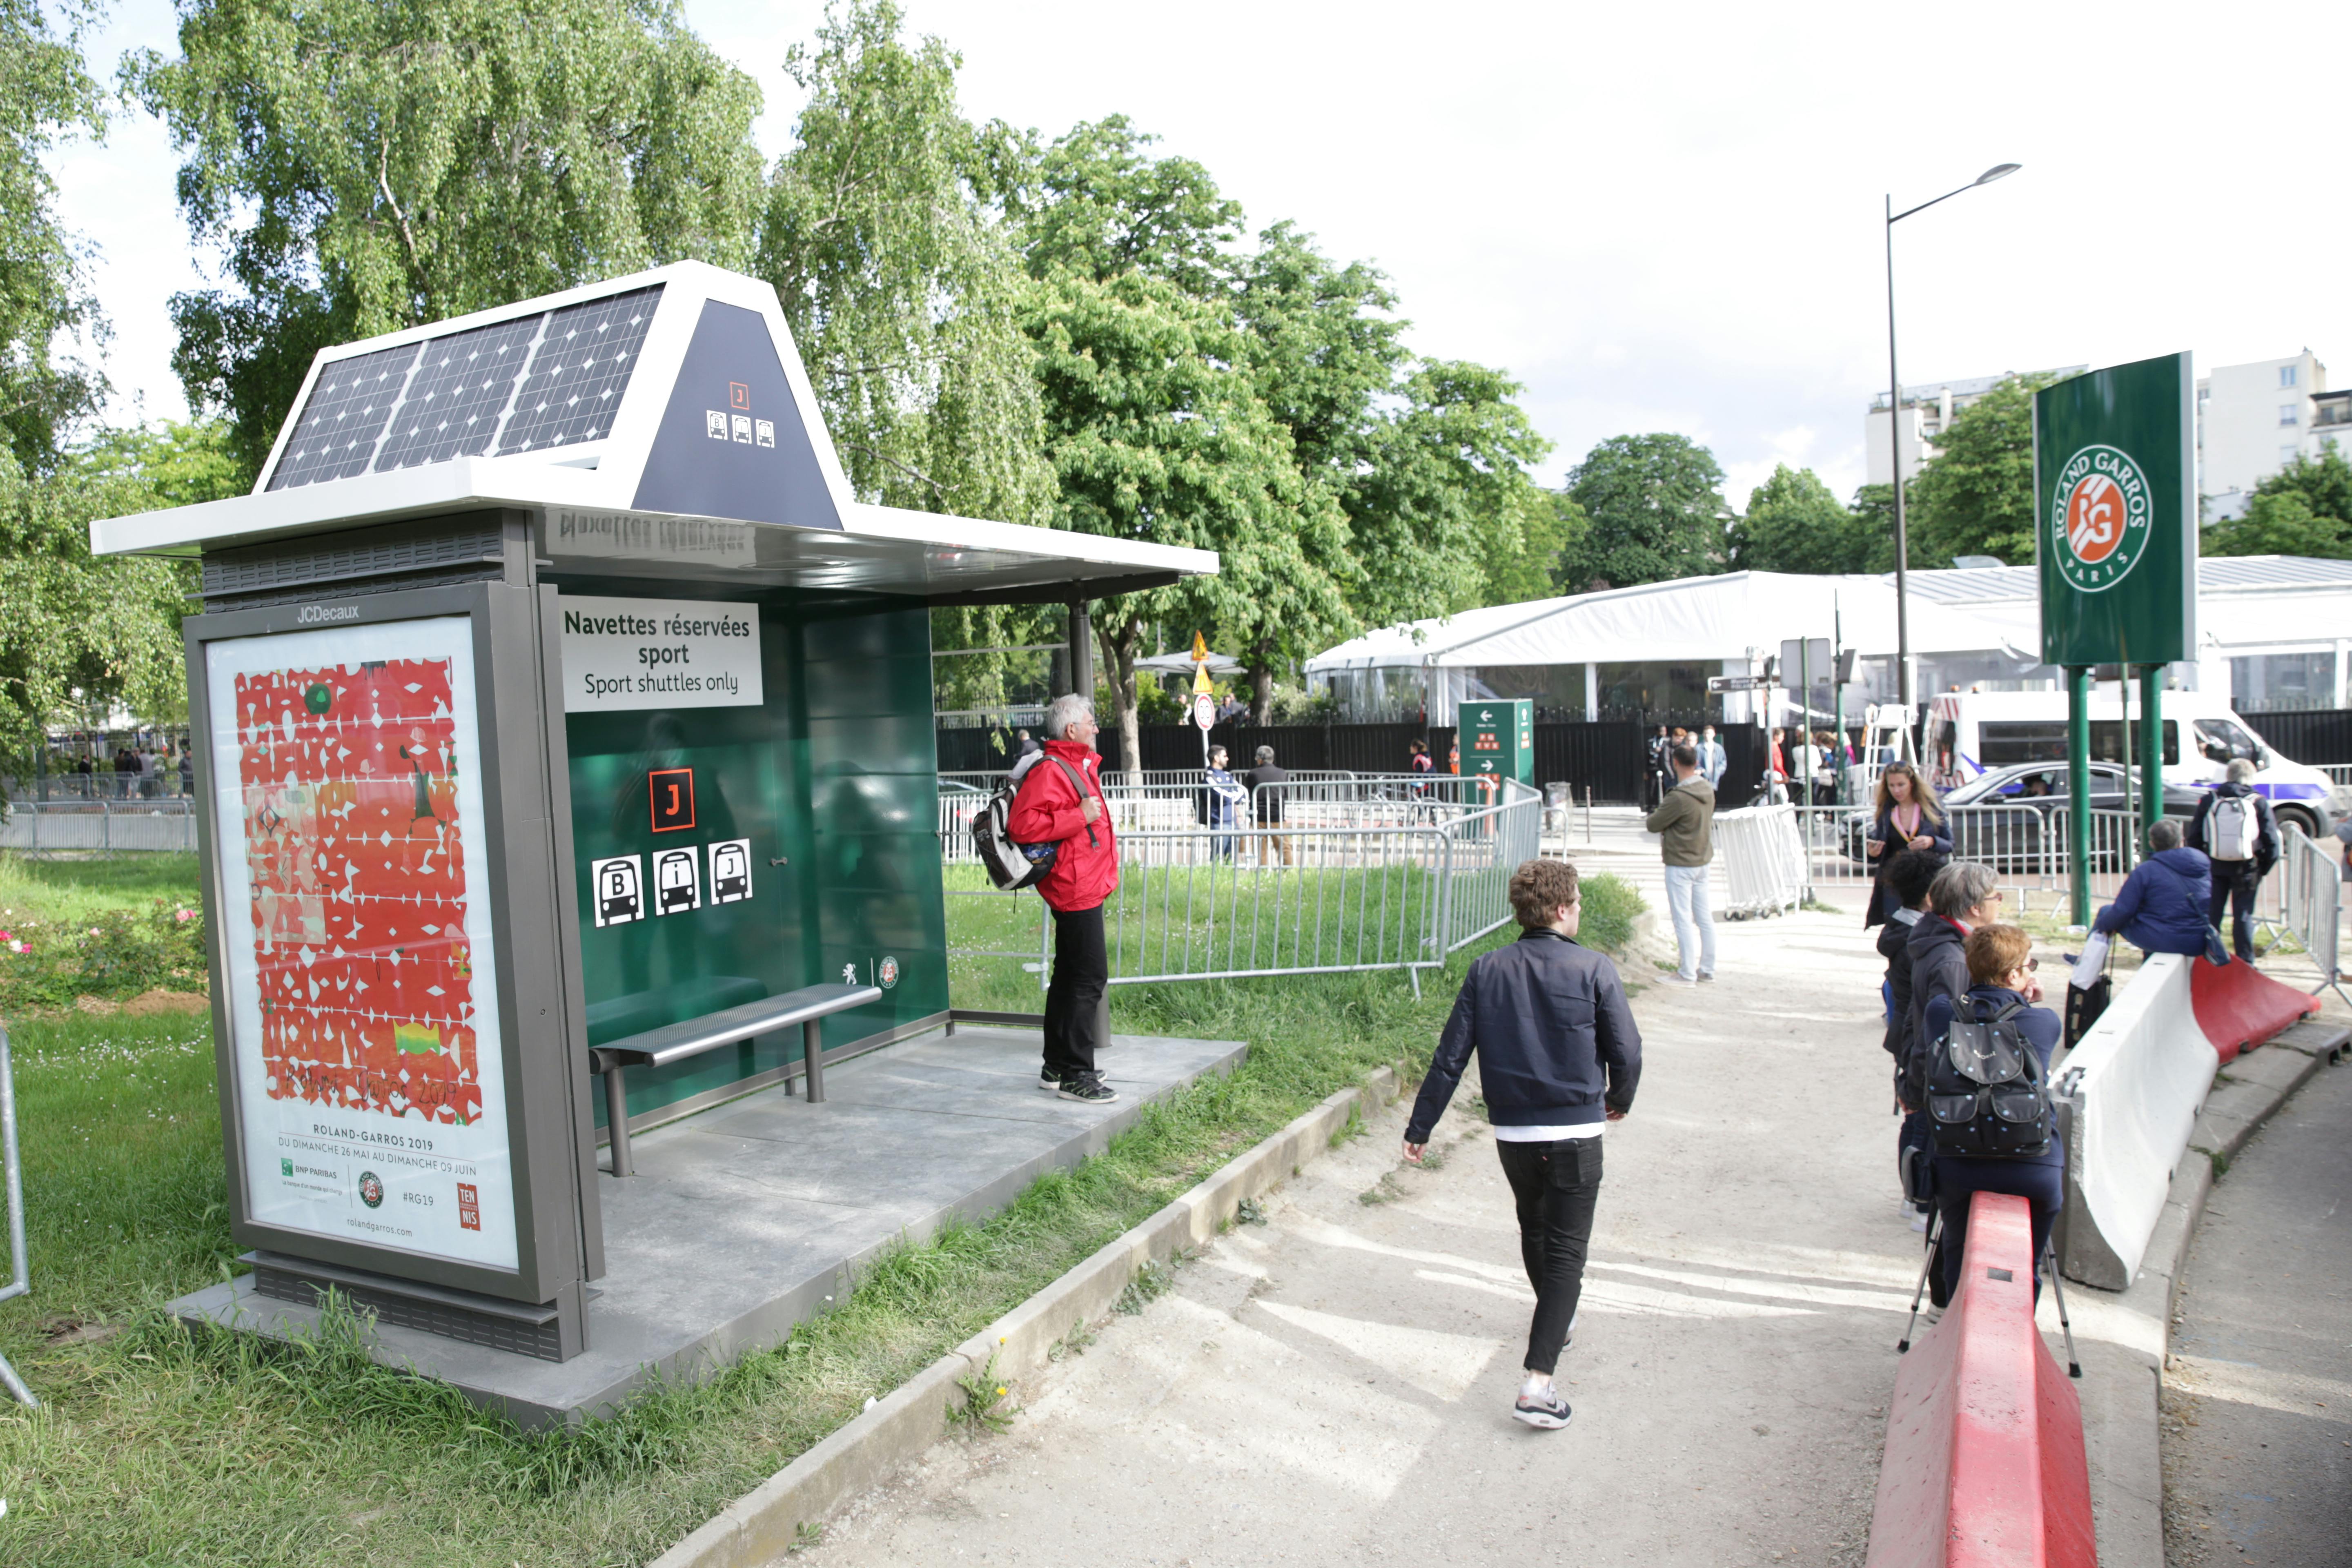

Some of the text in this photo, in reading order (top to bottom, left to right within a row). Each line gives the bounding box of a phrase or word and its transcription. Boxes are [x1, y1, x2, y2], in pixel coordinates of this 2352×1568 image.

[737, 389, 743, 403] J
[715, 418, 719, 427] B
[2056, 452, 2146, 540] ROLAND GARROS
[2066, 552, 2128, 583] PARIS
[298, 606, 359, 624] JCDecaux
[564, 611, 750, 637] Navettes réservées
[639, 644, 690, 669] sport
[585, 672, 738, 699] Sport shuttles only
[1200, 706, 1209, 719] 30
[666, 784, 679, 815] J
[612, 873, 625, 896] B
[727, 858, 734, 875] J
[286, 1065, 339, 1094] Roland
[419, 1081, 457, 1107] 2019
[314, 1124, 433, 1150] ROLAND-GARROS 2019
[279, 1137, 476, 1176] DU DIMANCHE 26 MAI AU DIMANCHE 09 JUIN
[295, 1165, 337, 1179] BNP PARIBAS
[360, 1173, 383, 1196] ROLAND GARROS
[460, 1189, 475, 1203] TEN
[364, 1198, 380, 1206] PARIS
[403, 1192, 434, 1206] #RG19
[347, 1218, 412, 1237] rolandgarros.com
[462, 1210, 477, 1225] NIS
